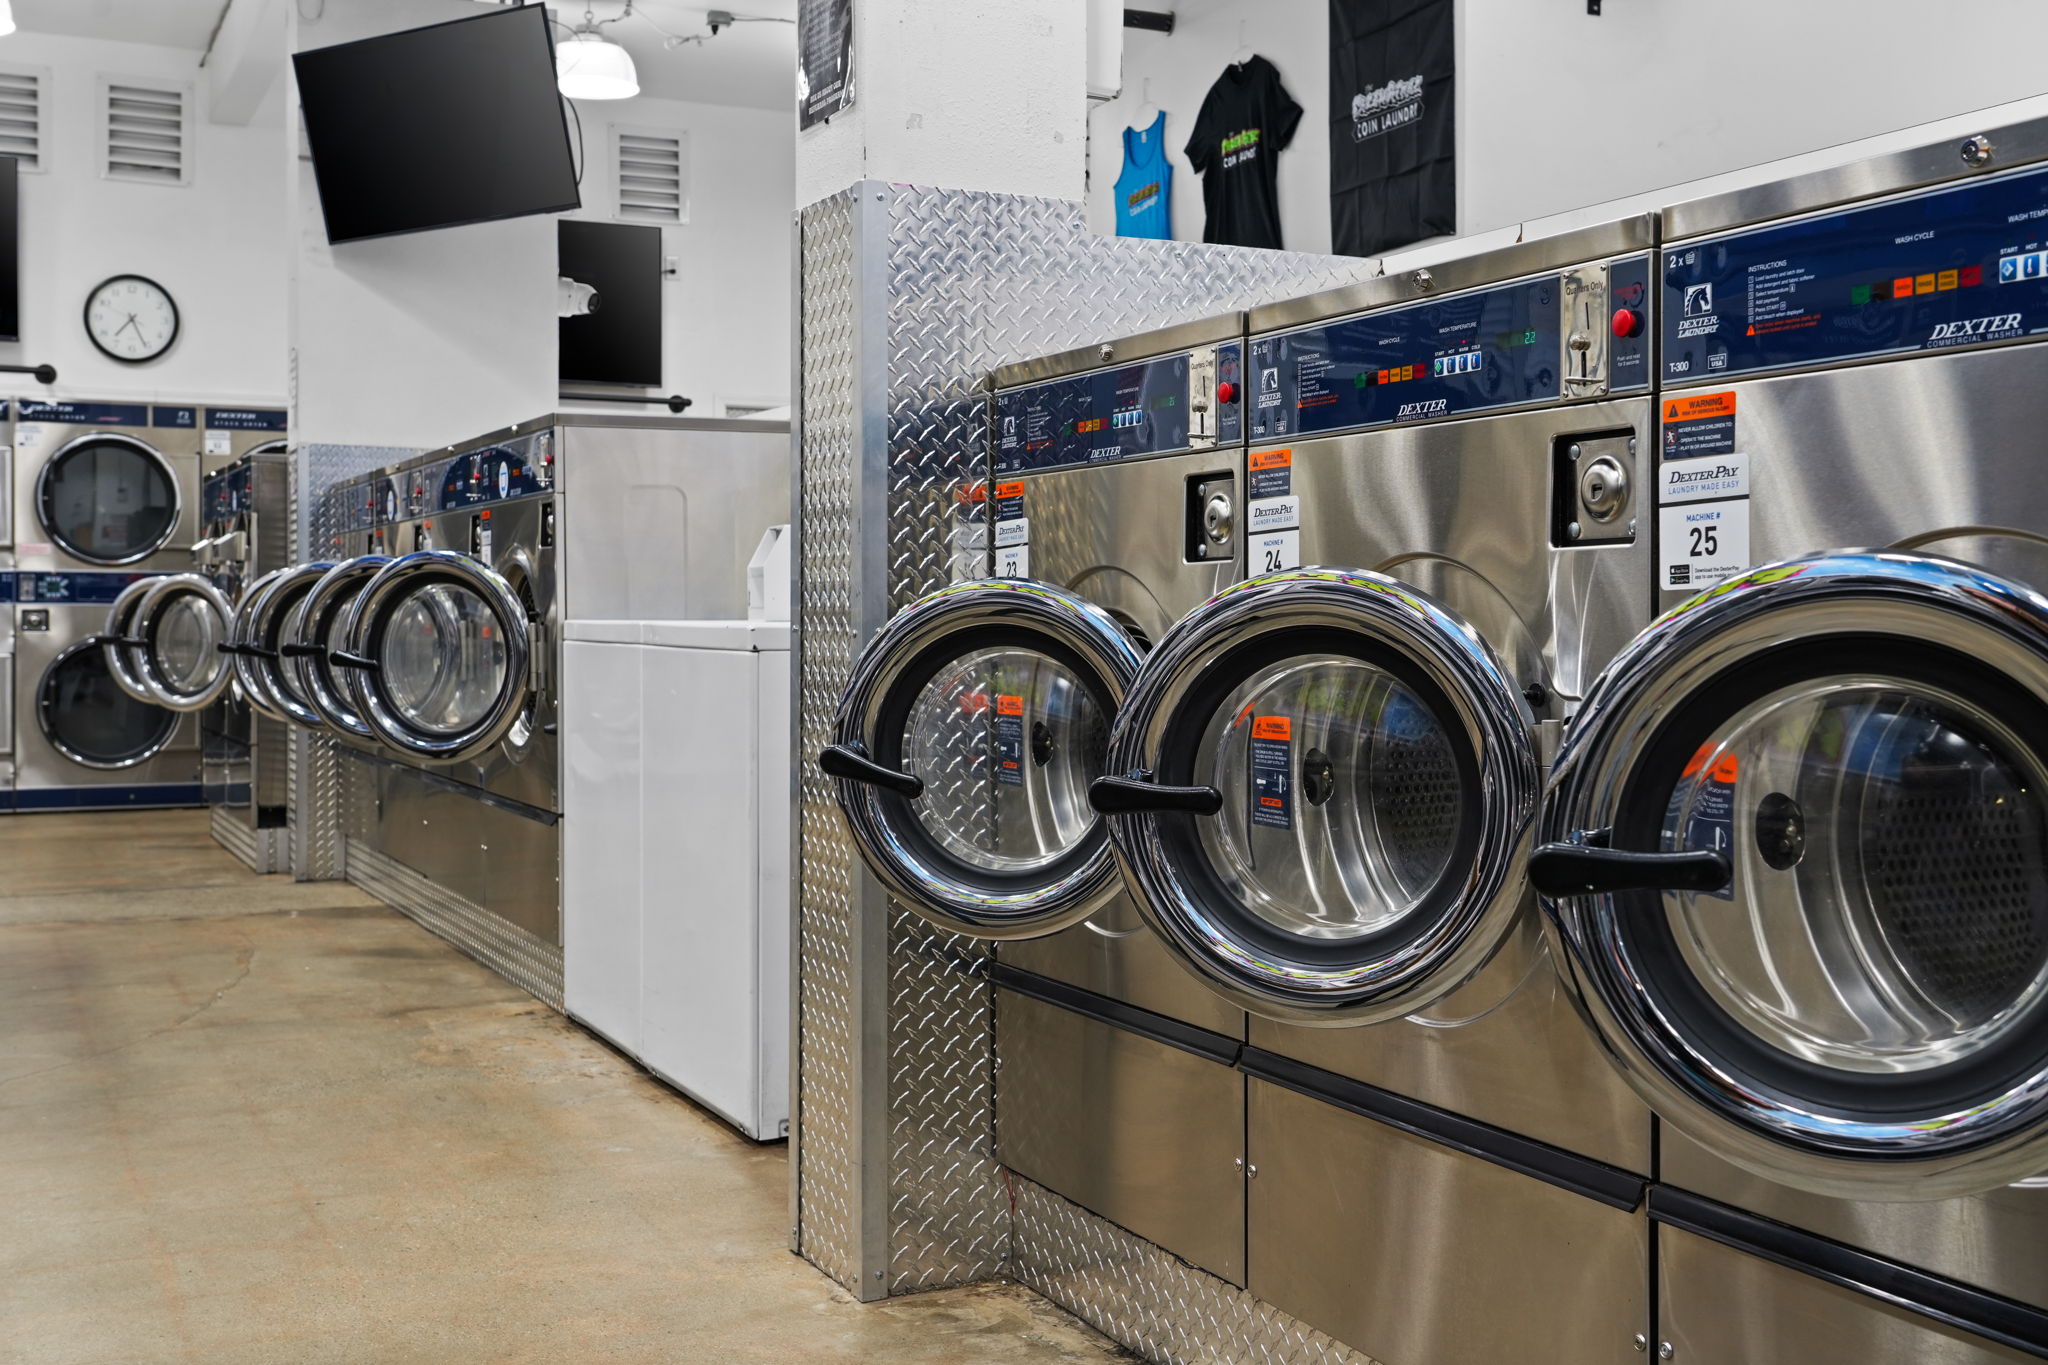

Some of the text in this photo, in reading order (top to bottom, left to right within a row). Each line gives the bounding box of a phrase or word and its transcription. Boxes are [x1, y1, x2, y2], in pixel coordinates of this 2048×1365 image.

[1357, 102, 1418, 138] COIN LAUNDRY
[2008, 213, 2028, 222] WASH
[1895, 231, 1934, 244] WASH CYCLE
[2000, 246, 2018, 255] START
[1670, 255, 1676, 268] 2
[1748, 260, 1787, 272] INSTRUCTIONS
[1590, 281, 1604, 291] Only
[1678, 316, 1716, 330] DEXTER
[1929, 313, 2022, 340] DEXTER
[1678, 324, 1720, 338] LAUNDRY
[1926, 328, 2024, 348] COMMERCIAL WASHER
[1254, 346, 1258, 356] 2
[1670, 361, 1689, 372] T-300
[1398, 399, 1446, 416] DEXTER
[1689, 398, 1722, 408] WARNING
[1396, 414, 1426, 422] COMMERCIAL
[1090, 446, 1120, 458] DEXTER
[1668, 480, 1740, 495] LAUNDRY MADE EASY
[1686, 512, 1714, 522] MACHINE
[1690, 526, 1718, 557] 25
[1266, 550, 1282, 572] 24
[1006, 561, 1016, 577] 23
